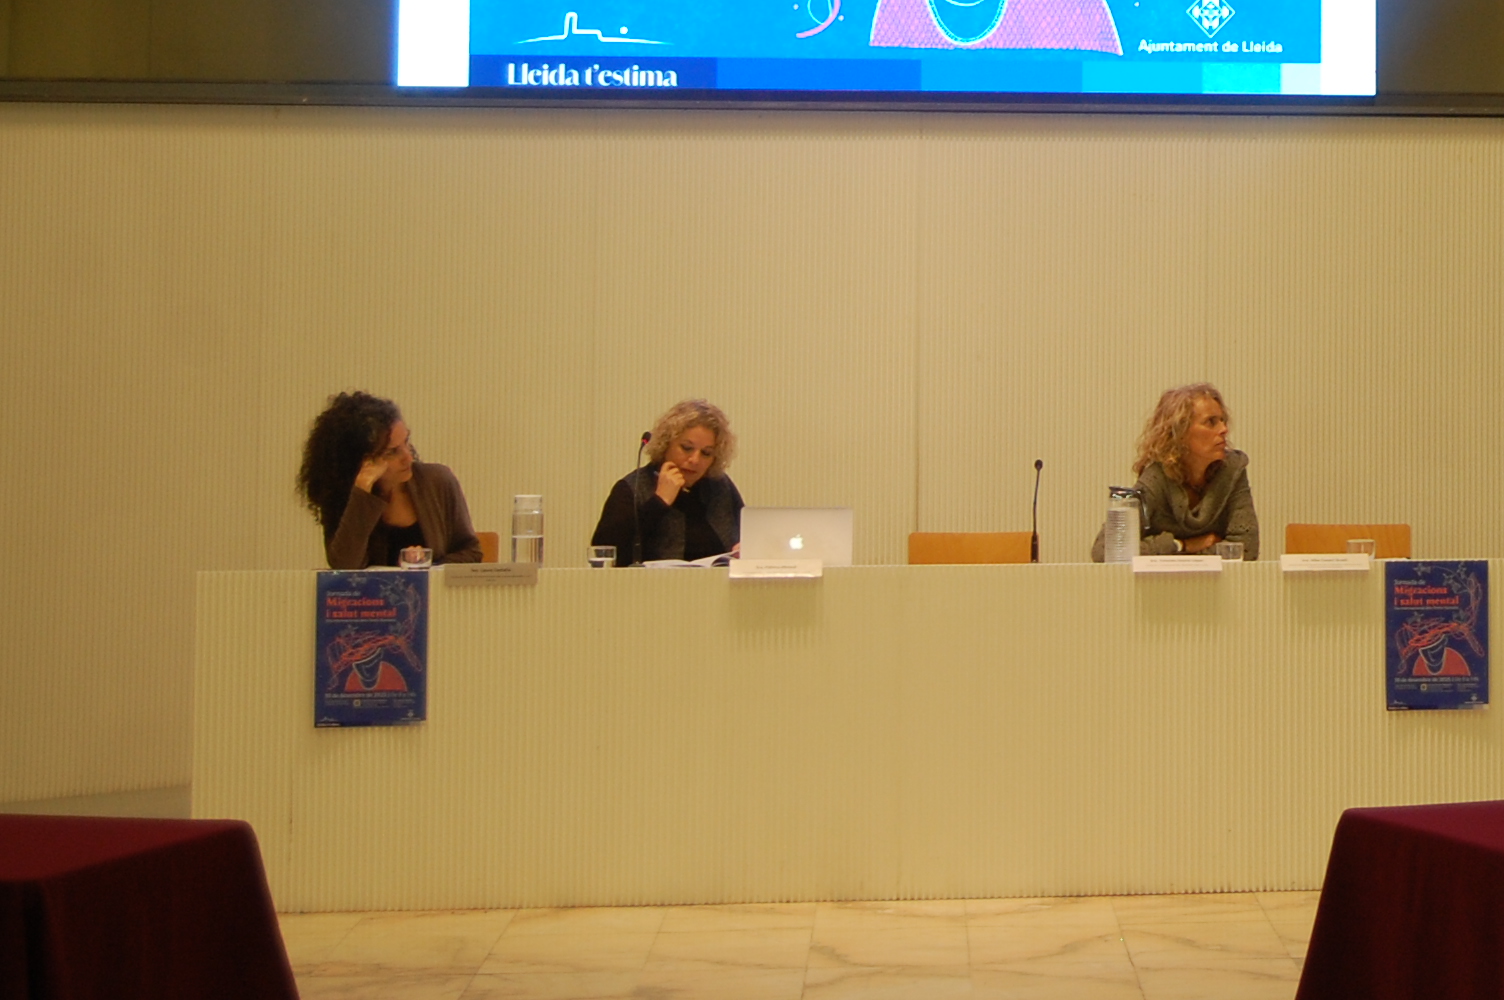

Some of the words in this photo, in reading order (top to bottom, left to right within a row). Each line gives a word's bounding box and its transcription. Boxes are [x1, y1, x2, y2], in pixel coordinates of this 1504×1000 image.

[1138, 39, 1218, 54] Ajuntament
[1221, 41, 1239, 53] de
[1242, 41, 1283, 53] Lleida
[507, 63, 580, 86] Lleida
[585, 63, 678, 87] t'estima
[1394, 585, 1448, 596] Migracions
[326, 597, 385, 608] Migracions
[1400, 596, 1423, 606] salut
[1426, 595, 1459, 606] mental
[360, 606, 397, 618] mental
